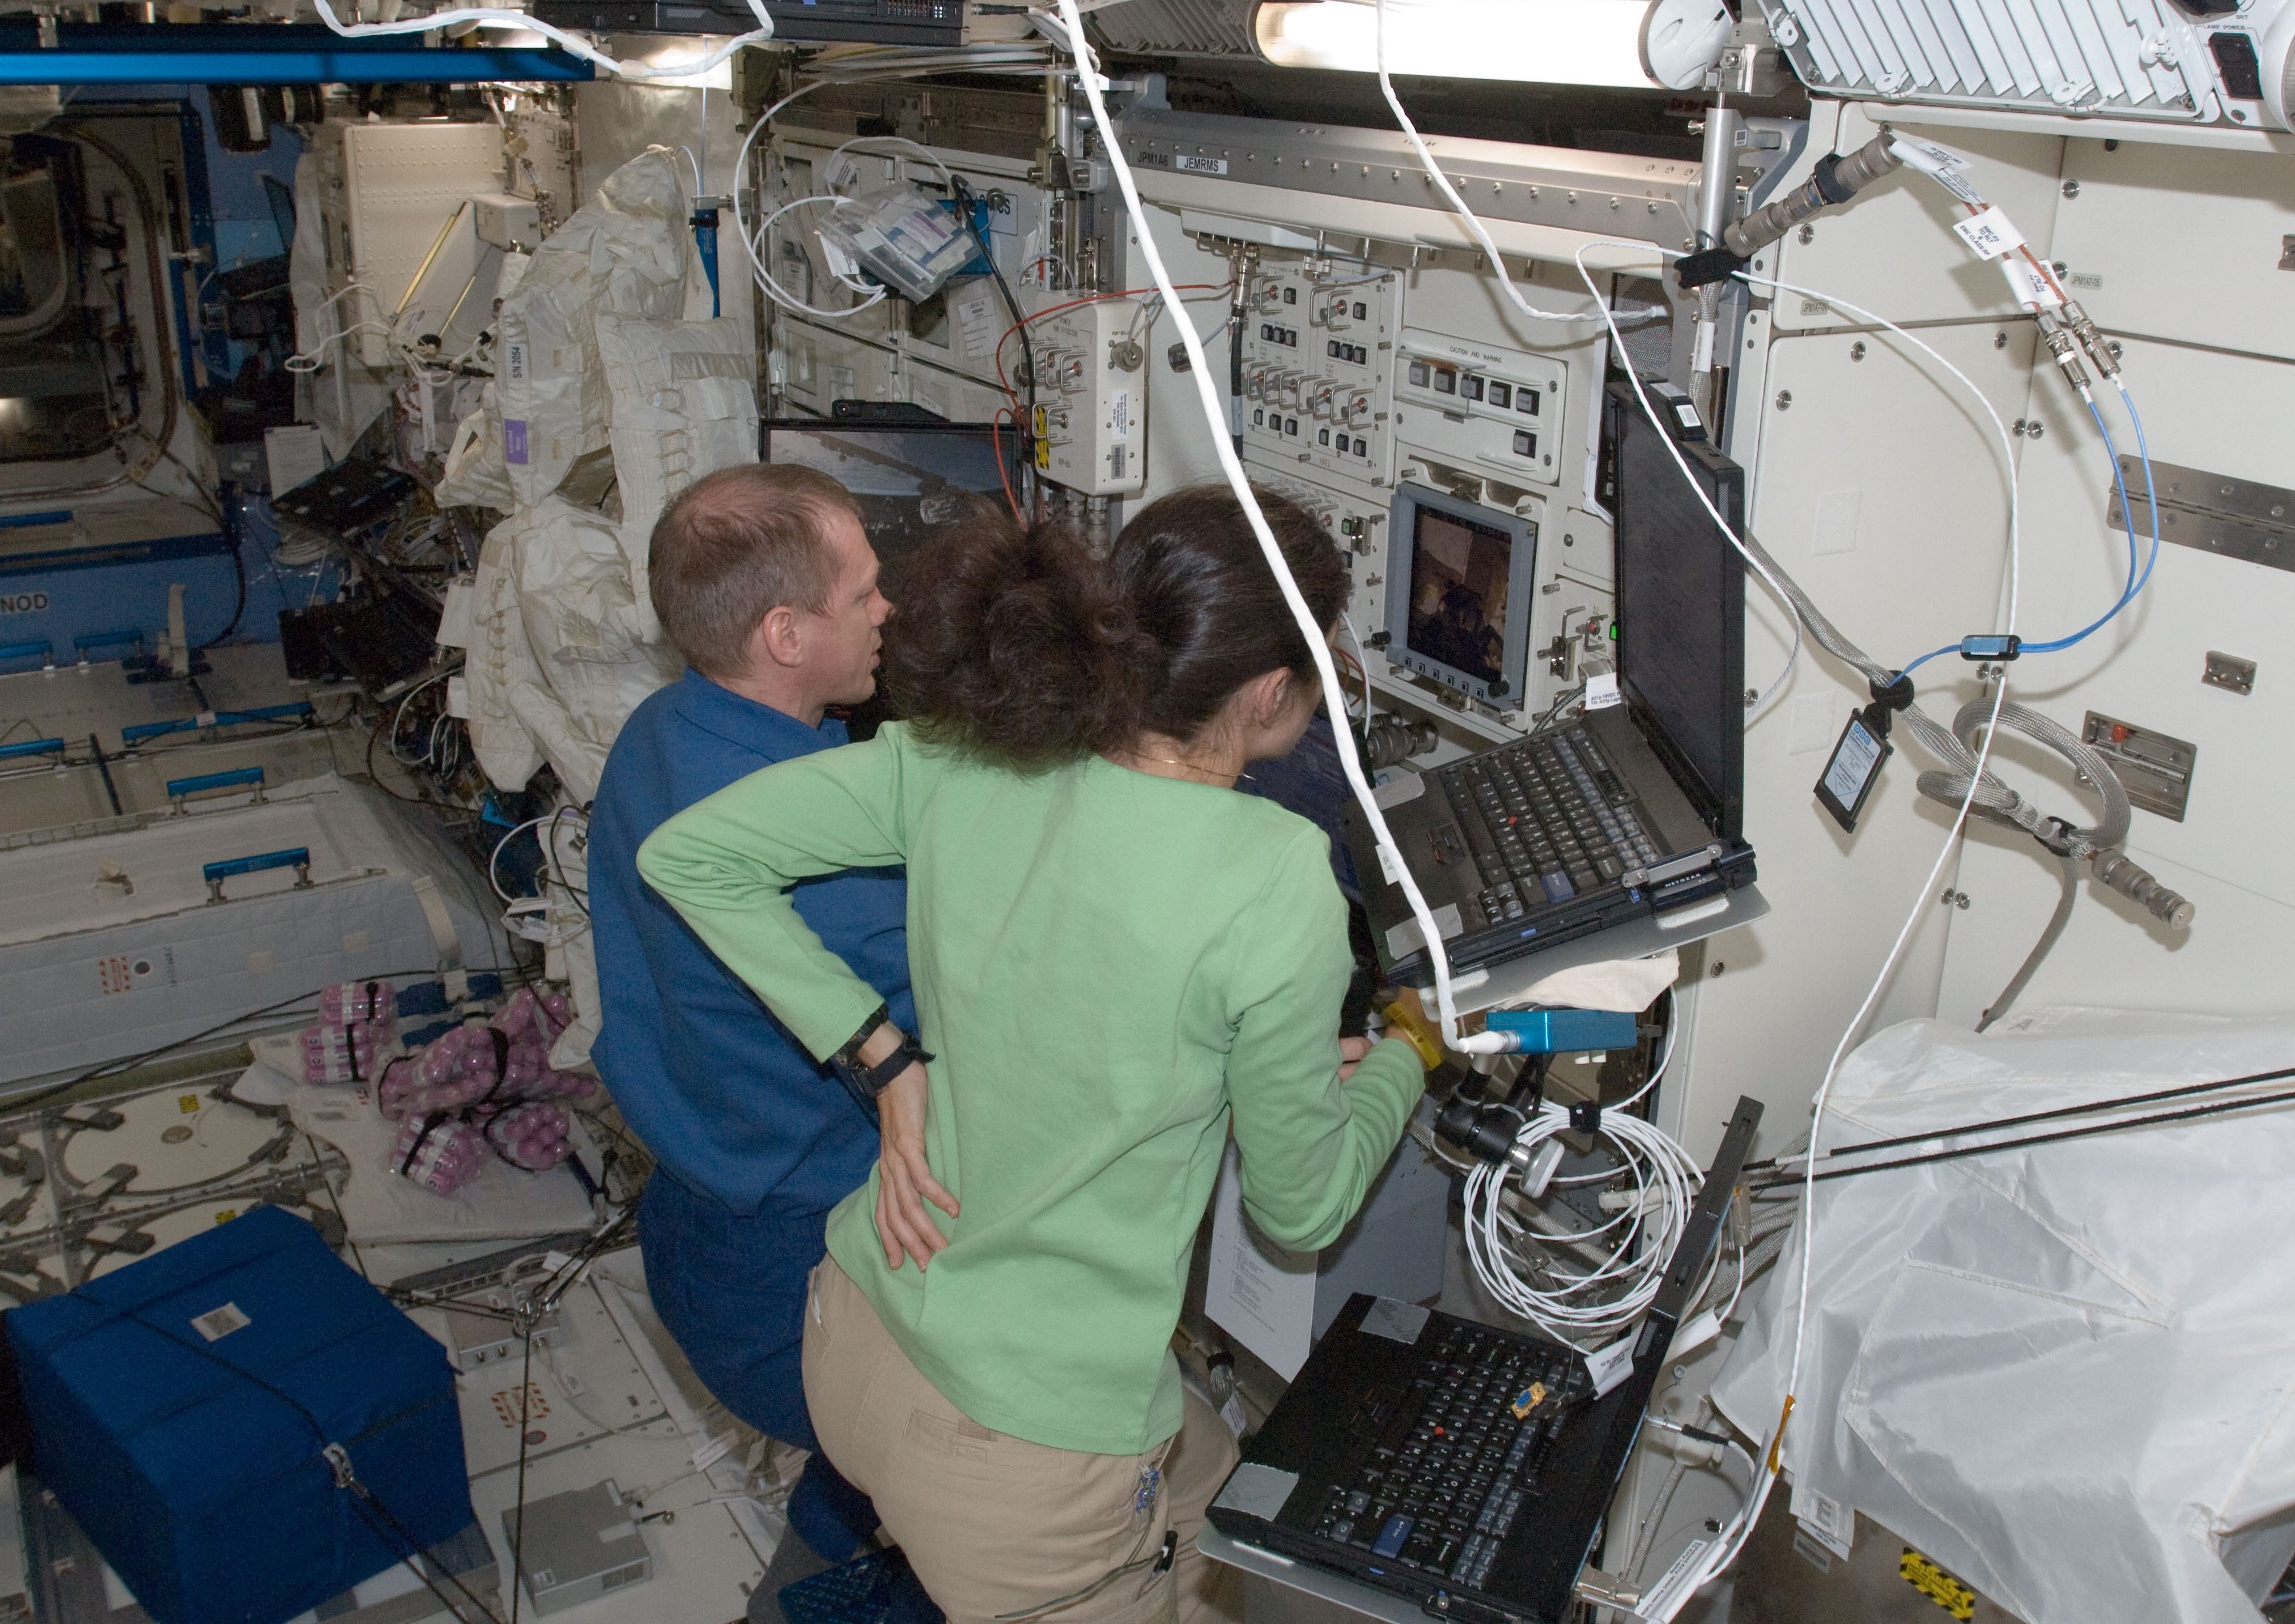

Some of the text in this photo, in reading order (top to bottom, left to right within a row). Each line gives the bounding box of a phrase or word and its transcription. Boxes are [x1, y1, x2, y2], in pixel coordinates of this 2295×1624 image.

[1138, 151, 1168, 167] JPM1A6
[1184, 157, 1218, 172] JEMRMS
[1960, 225, 1971, 235] EMC
[1983, 225, 1994, 236] BMC
[1061, 327, 1078, 337] EFFECTOR
[1450, 346, 1467, 356] CAUTION
[1483, 354, 1502, 363] WARNING
[511, 346, 522, 379] S/N 2054
[1665, 873, 1701, 887] NETGEAR
